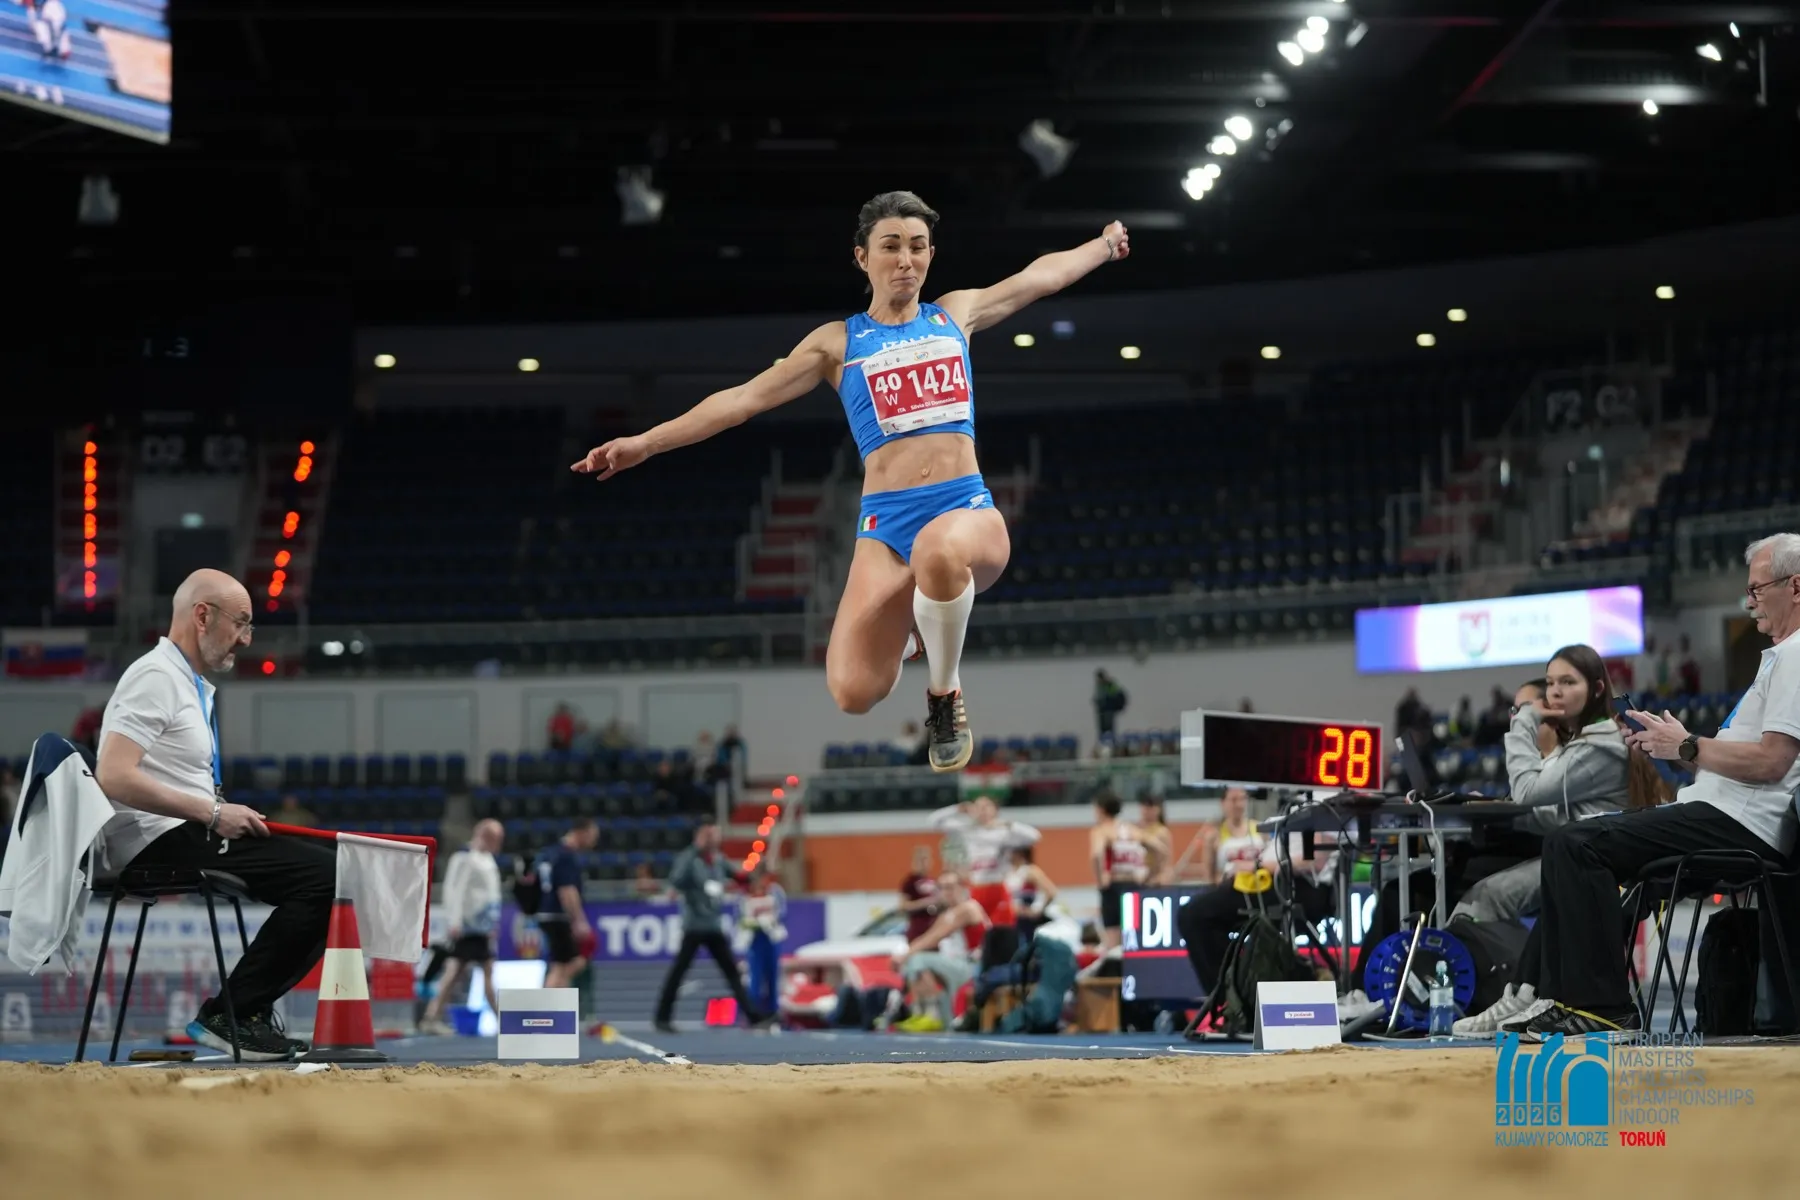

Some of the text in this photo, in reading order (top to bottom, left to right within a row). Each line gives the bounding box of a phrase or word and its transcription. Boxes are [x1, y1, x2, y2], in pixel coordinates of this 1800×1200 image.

[875, 361, 965, 398] 40 1424
[884, 393, 898, 406] W
[1318, 728, 1372, 787] 28
[1142, 896, 1172, 948] DI
